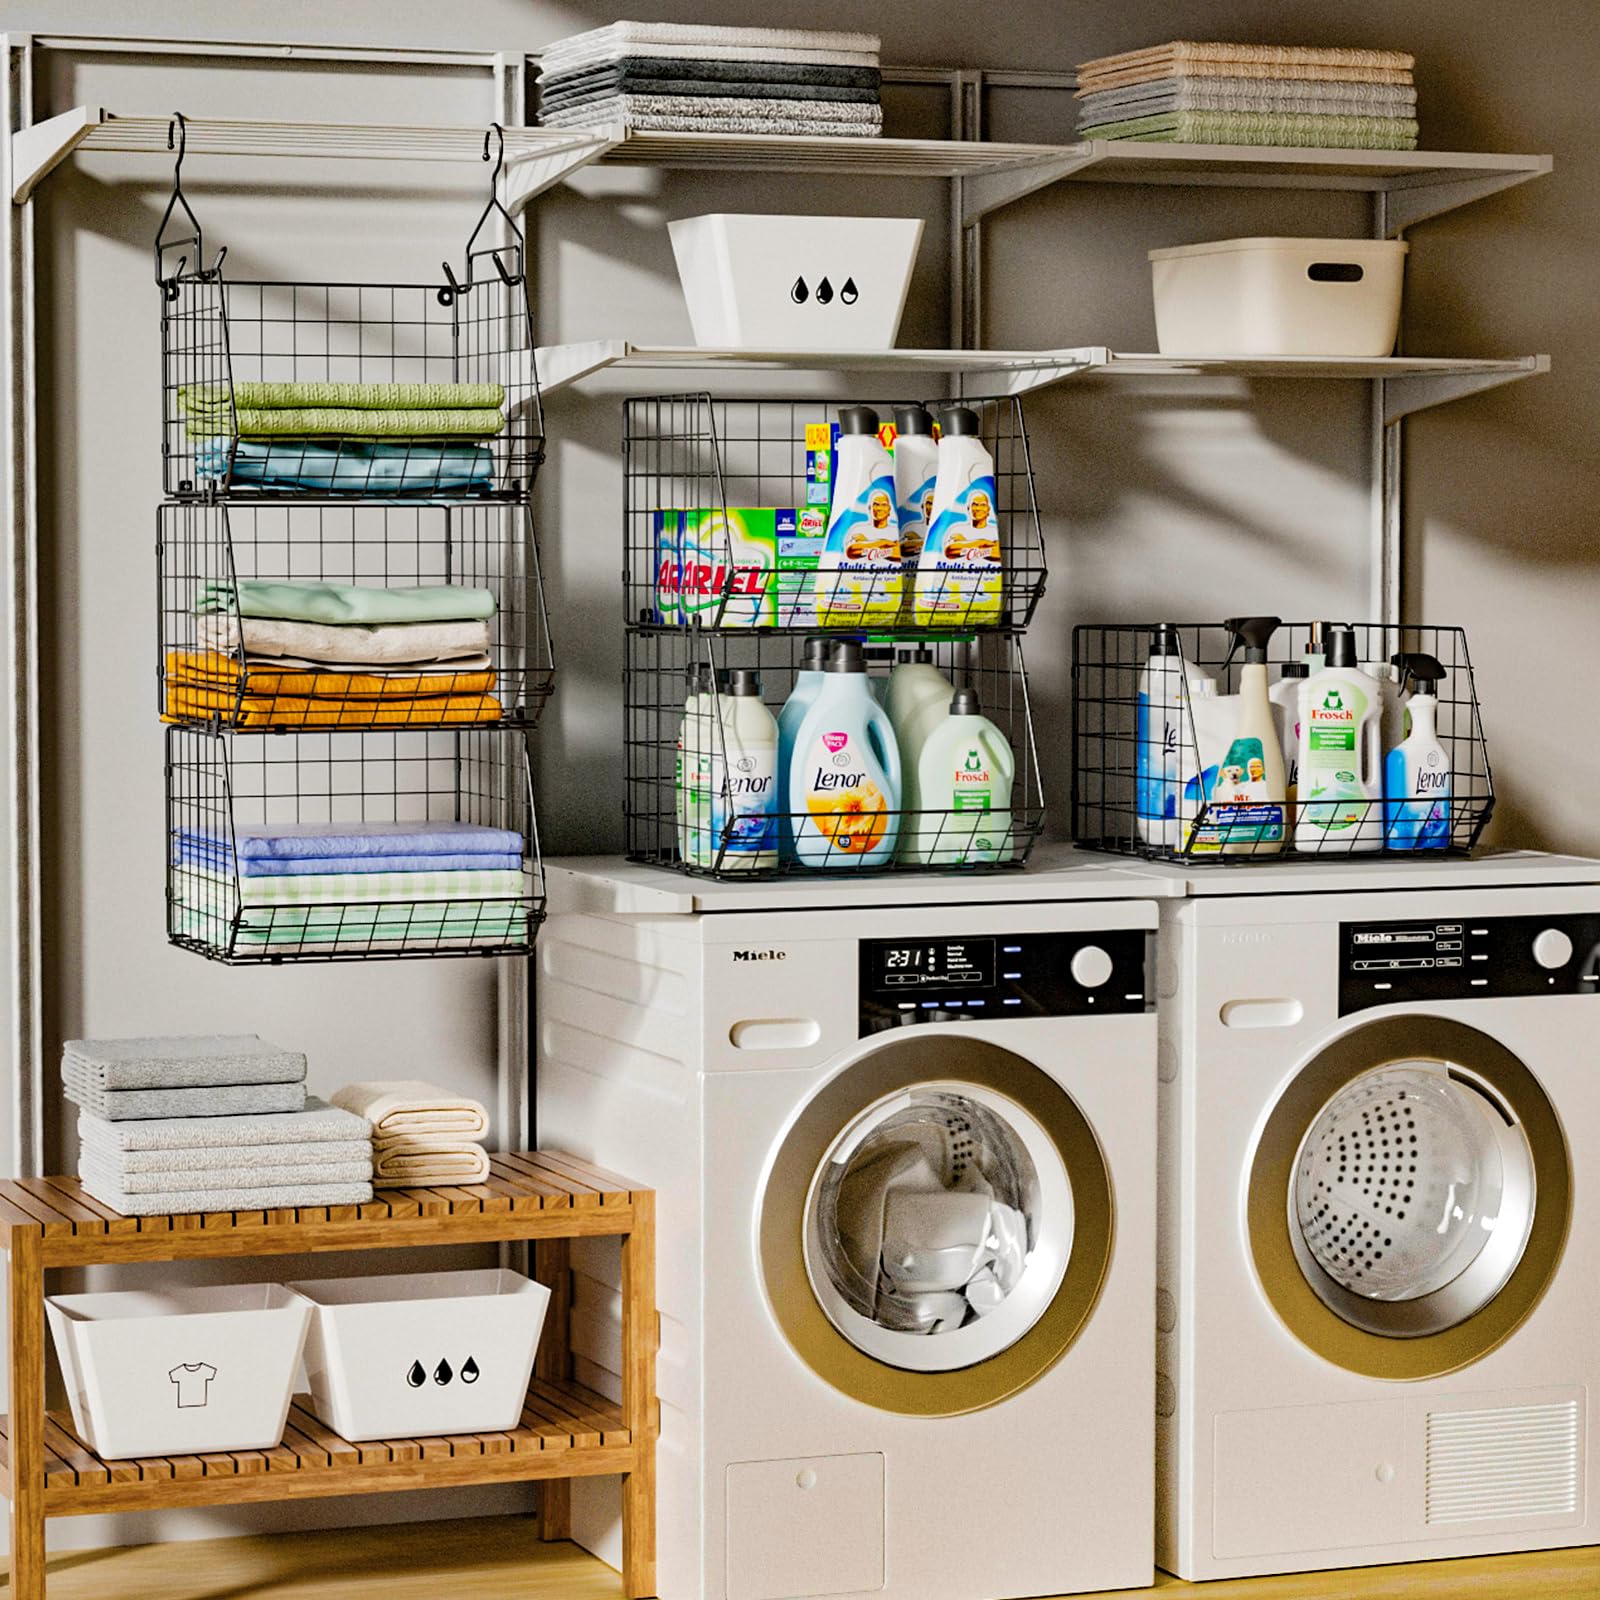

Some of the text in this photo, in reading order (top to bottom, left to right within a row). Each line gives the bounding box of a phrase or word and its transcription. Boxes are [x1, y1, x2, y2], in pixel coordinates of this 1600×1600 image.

[1311, 708, 1353, 720] Frosch
[814, 767, 865, 792] Lenor
[955, 771, 989, 782] Frosch
[1416, 767, 1451, 795] Lenor
[733, 949, 787, 962] Miele
[887, 950, 921, 967] 2:31
